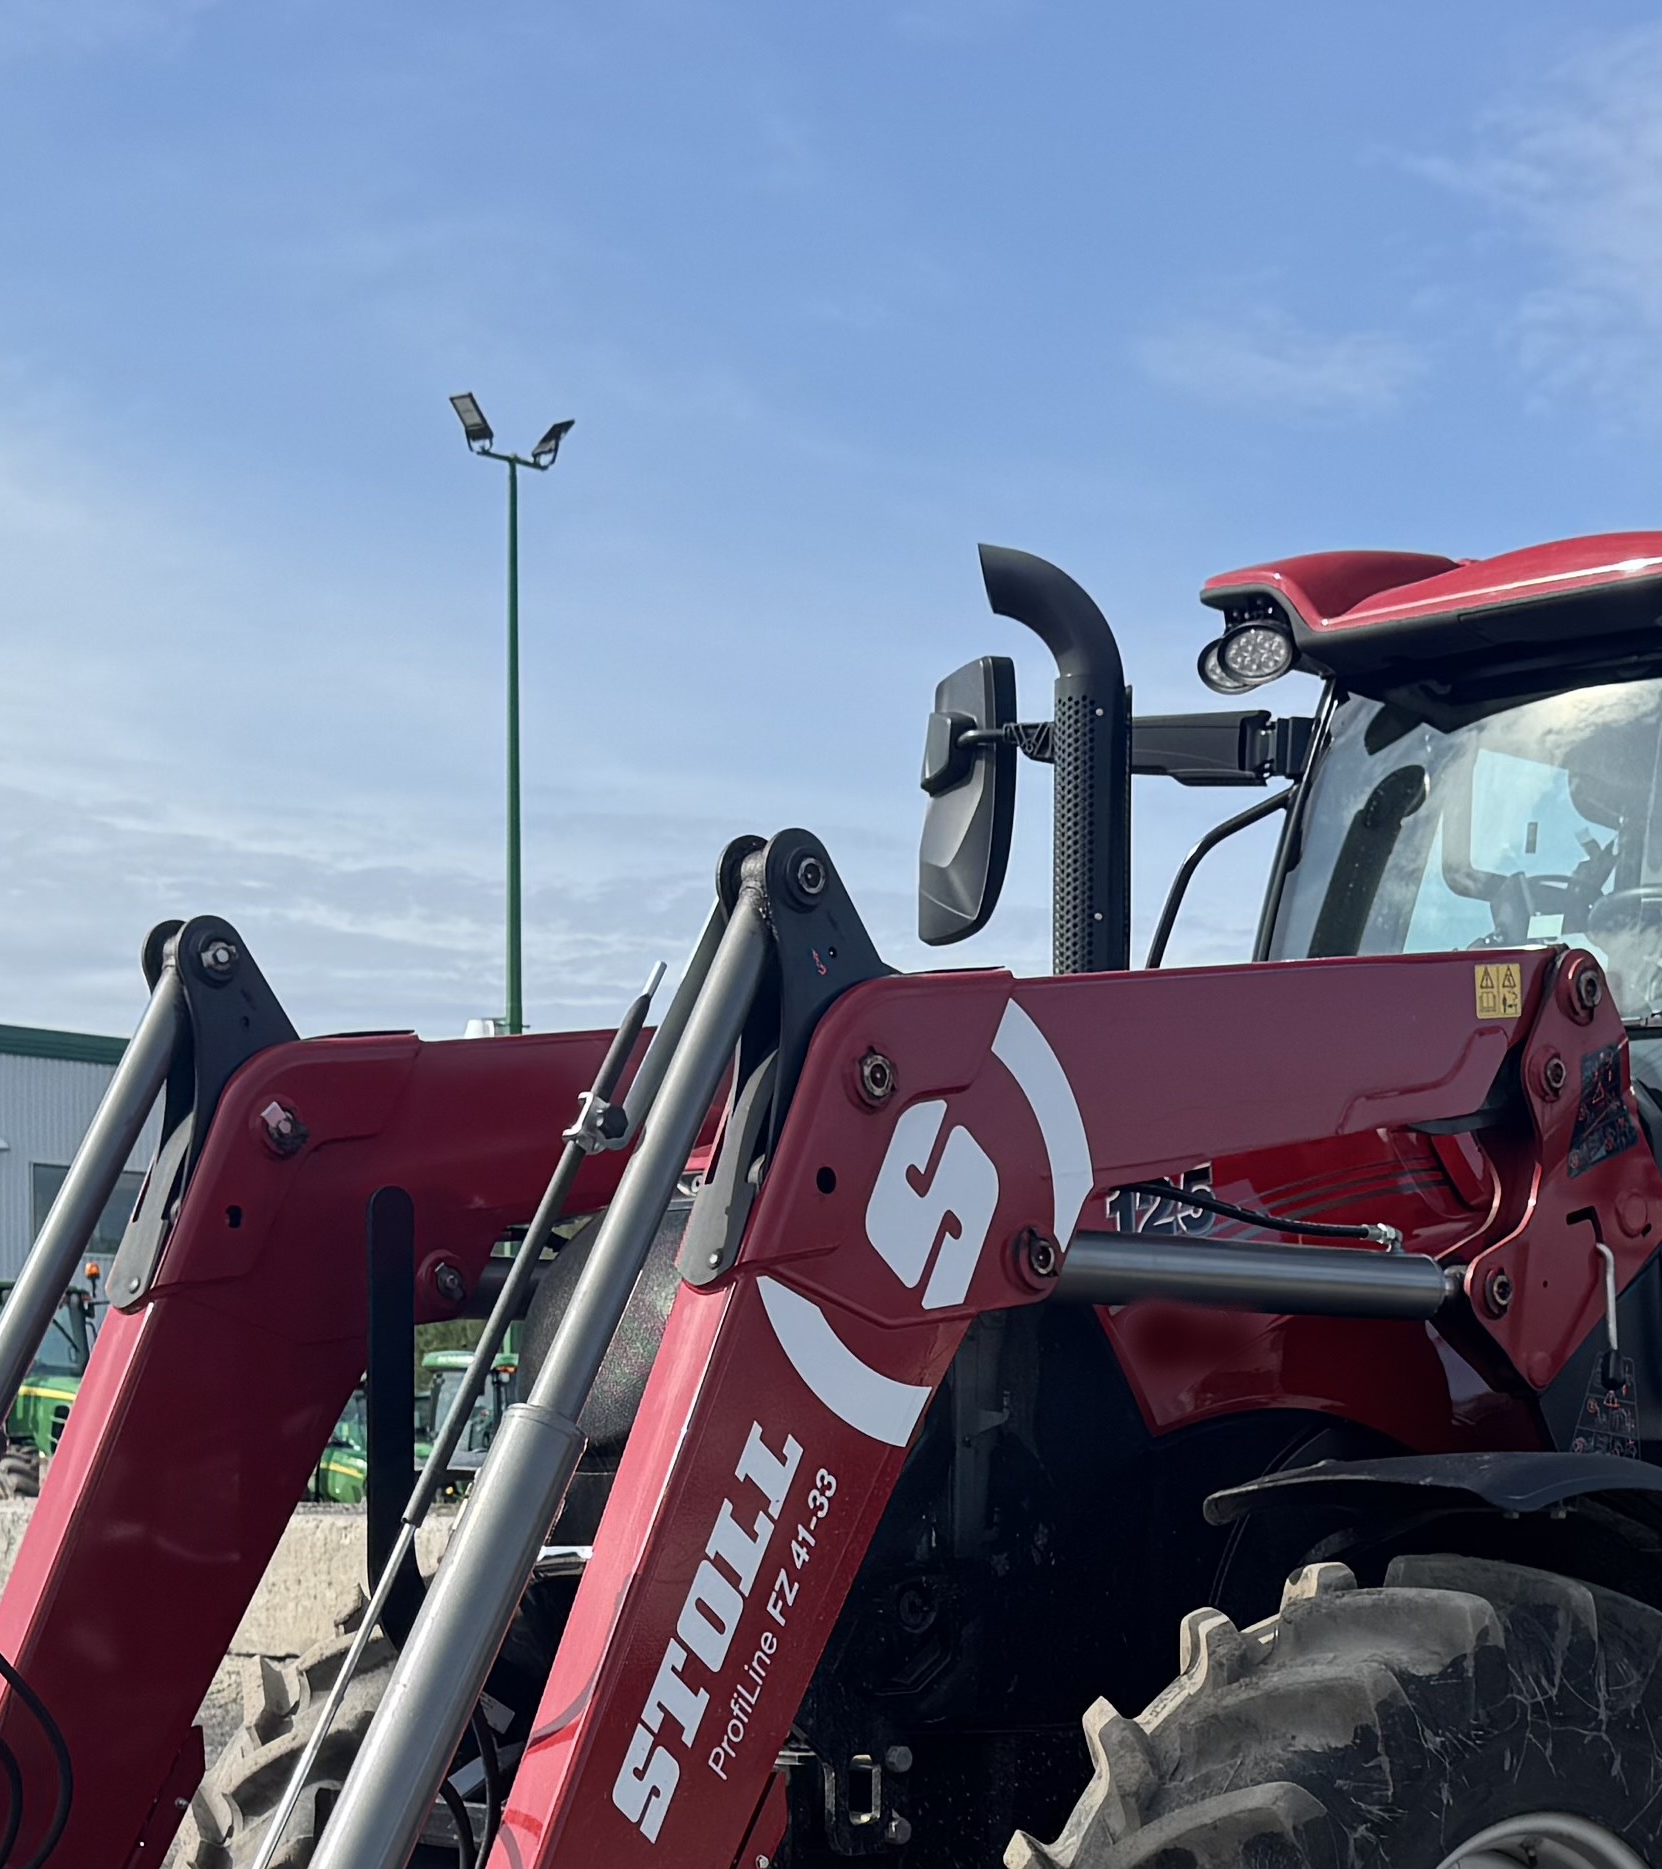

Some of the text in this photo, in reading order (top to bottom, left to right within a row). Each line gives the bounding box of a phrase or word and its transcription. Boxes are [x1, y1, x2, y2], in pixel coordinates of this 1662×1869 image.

[1106, 1161, 1217, 1236] 125
[612, 1420, 804, 1844] STOLL
[708, 1468, 838, 1781] ProfiLine FZ 41-33
